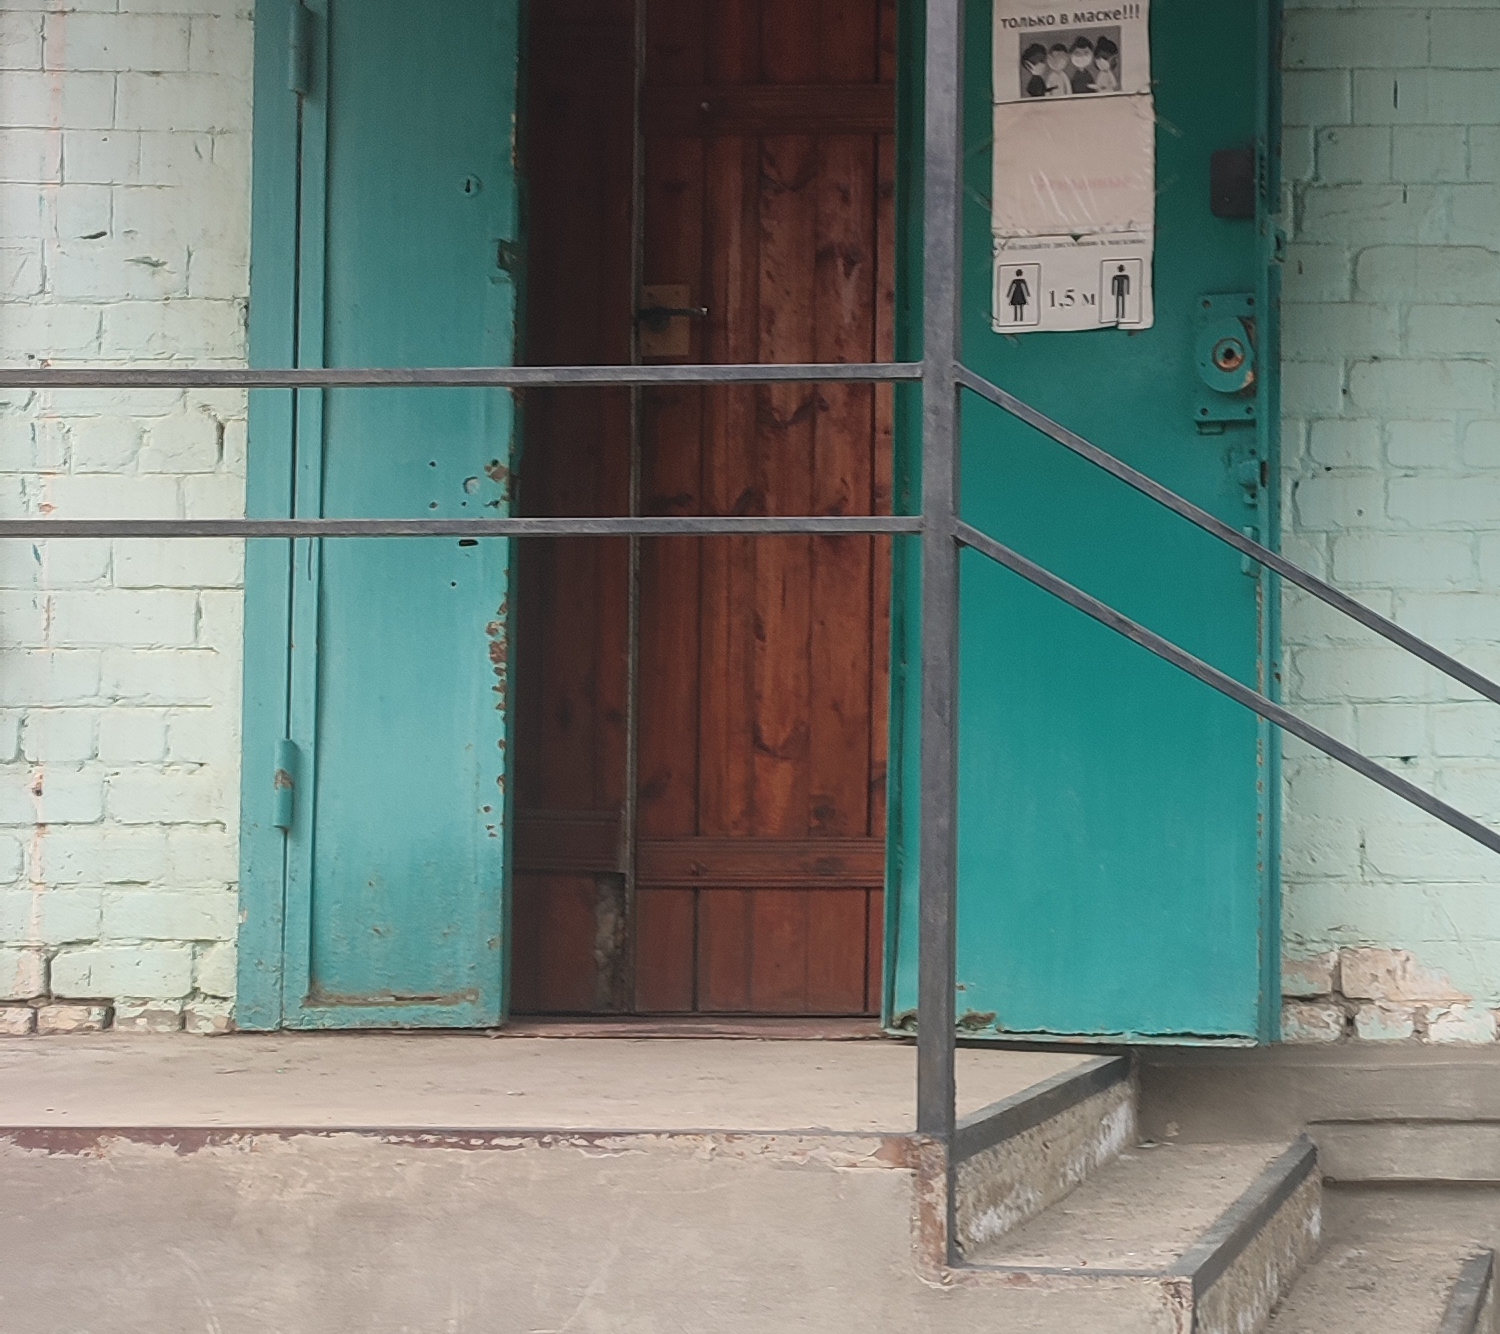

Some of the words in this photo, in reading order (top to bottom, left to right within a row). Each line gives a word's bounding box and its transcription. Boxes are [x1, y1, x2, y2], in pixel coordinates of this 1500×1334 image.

[1000, 14, 1056, 29] только
[1060, 14, 1069, 25] в
[1073, 3, 1140, 24] маске!!!
[1049, 288, 1075, 311] 1,5
